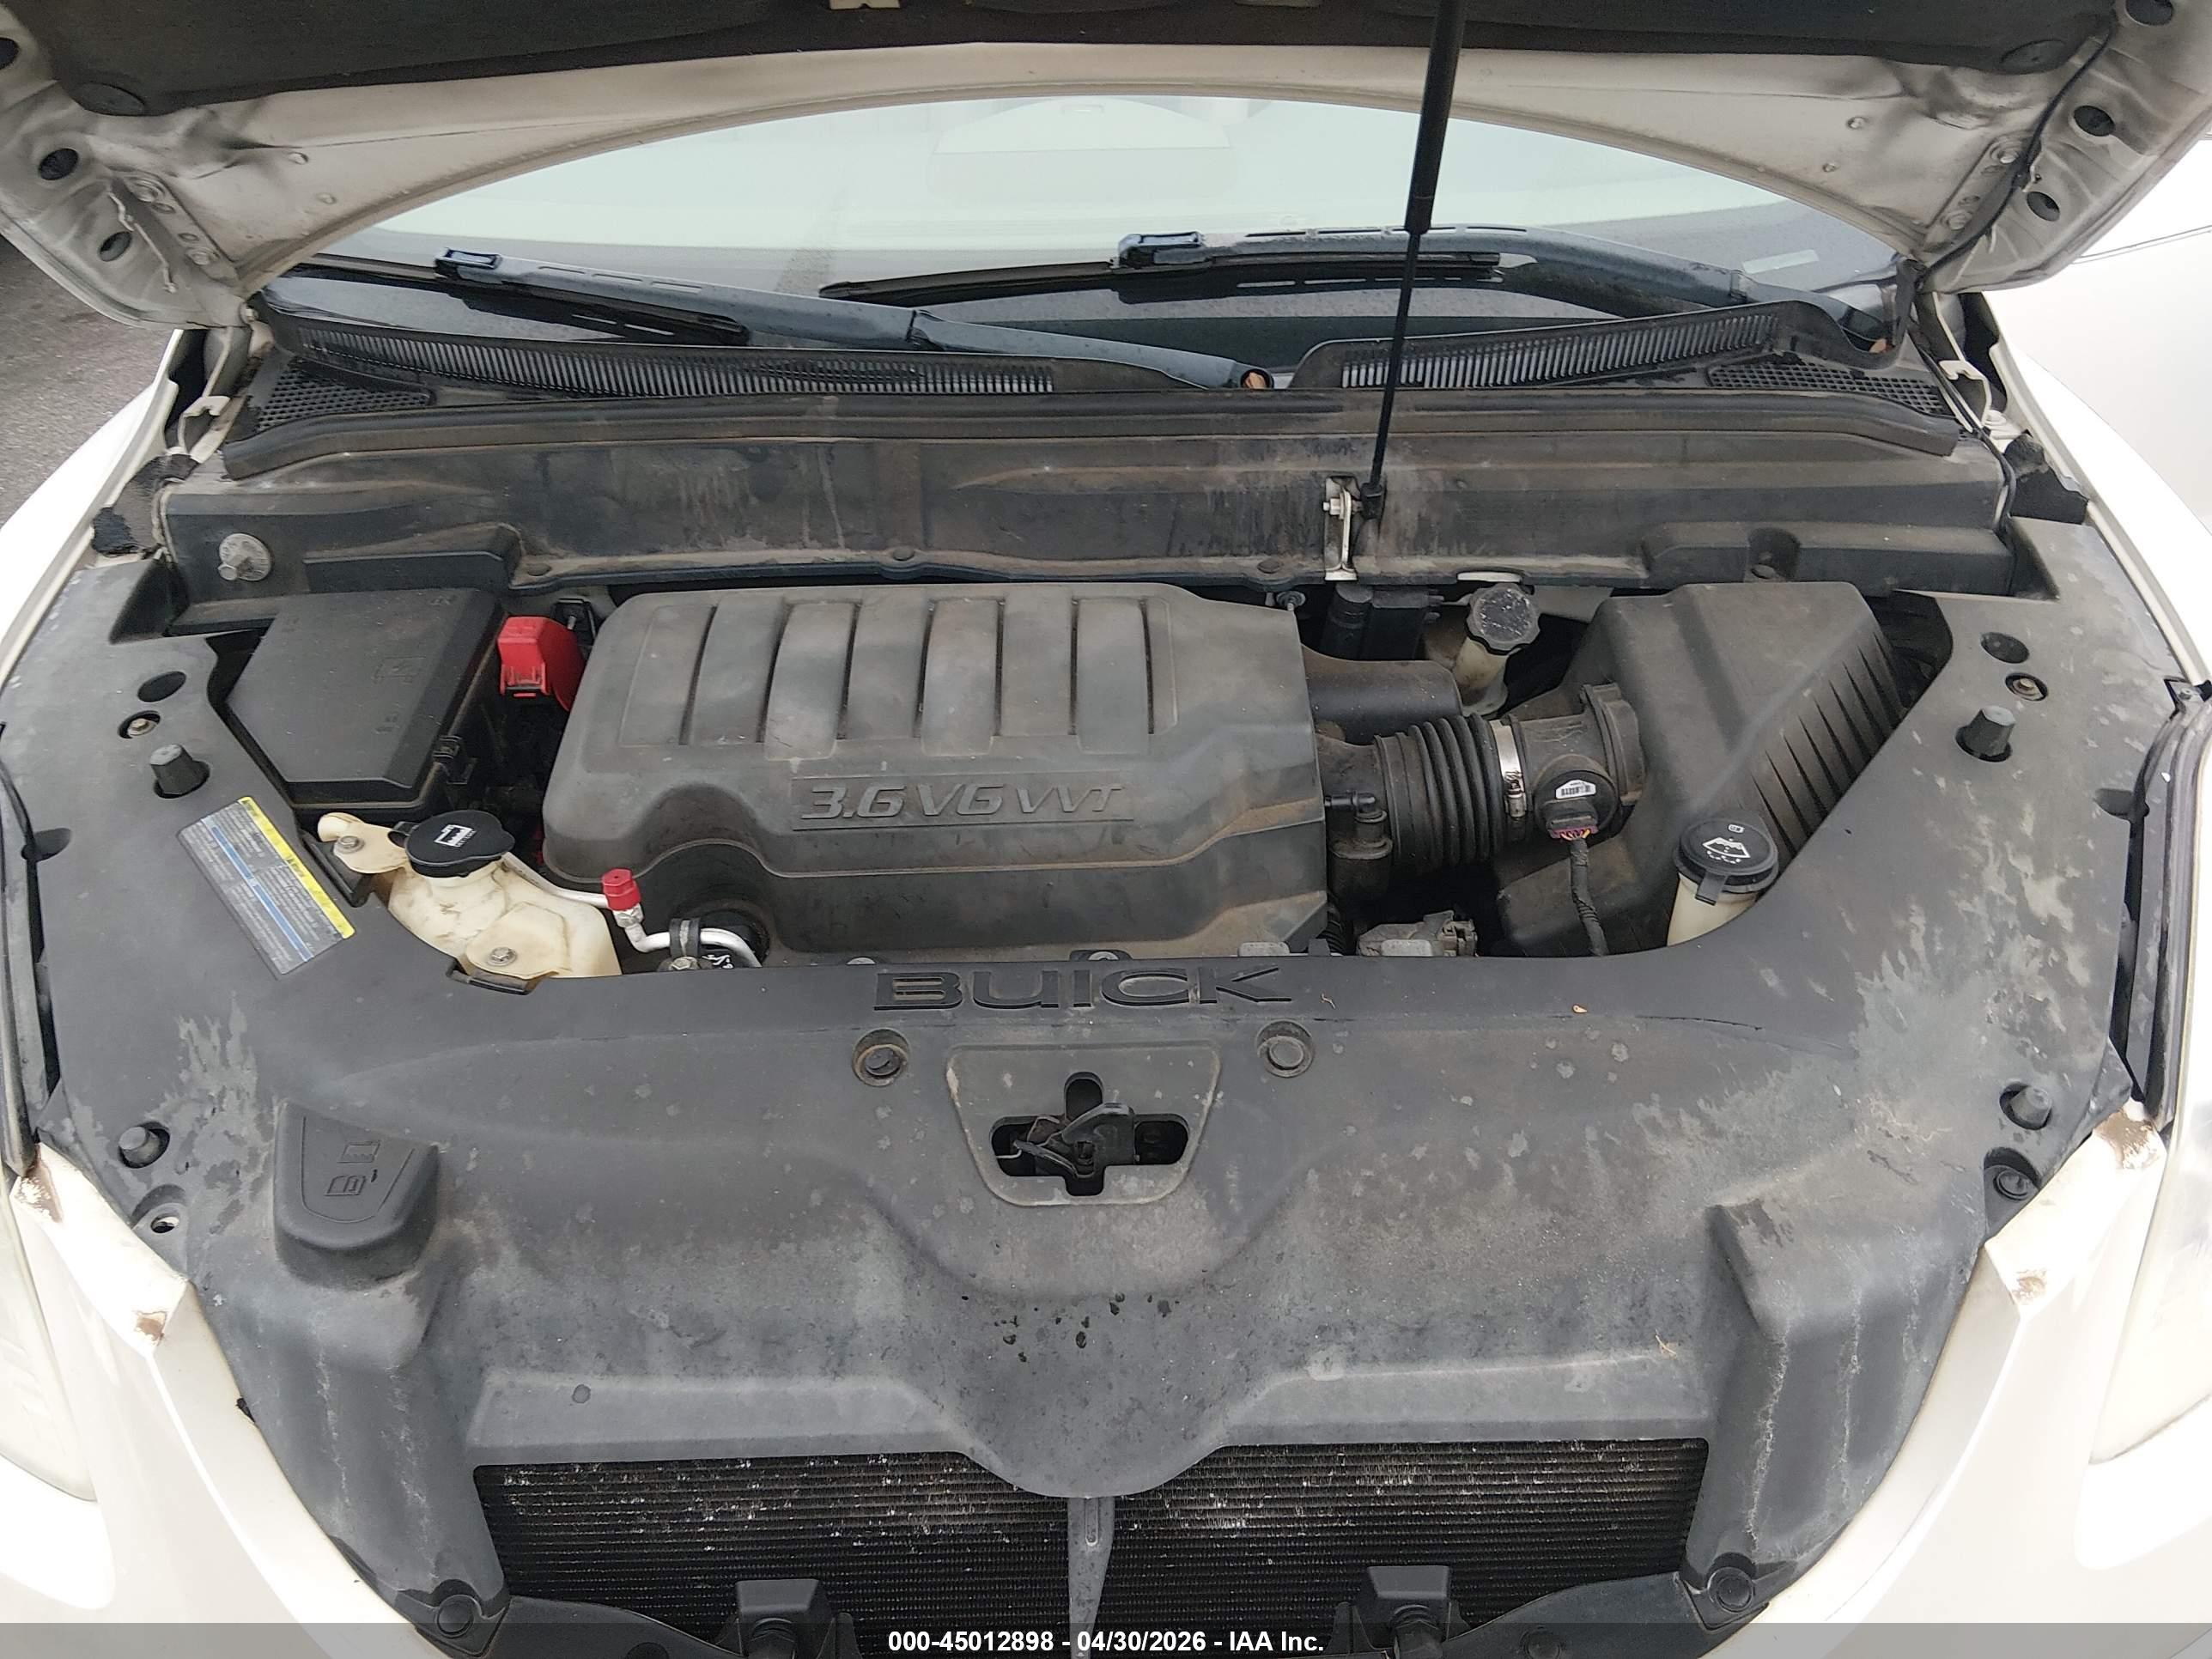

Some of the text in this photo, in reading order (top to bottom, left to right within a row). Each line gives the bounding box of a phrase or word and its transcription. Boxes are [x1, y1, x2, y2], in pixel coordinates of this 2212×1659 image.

[800, 782, 1126, 820] 3.6 V6 VVT
[873, 966, 1293, 1011] BUICK
